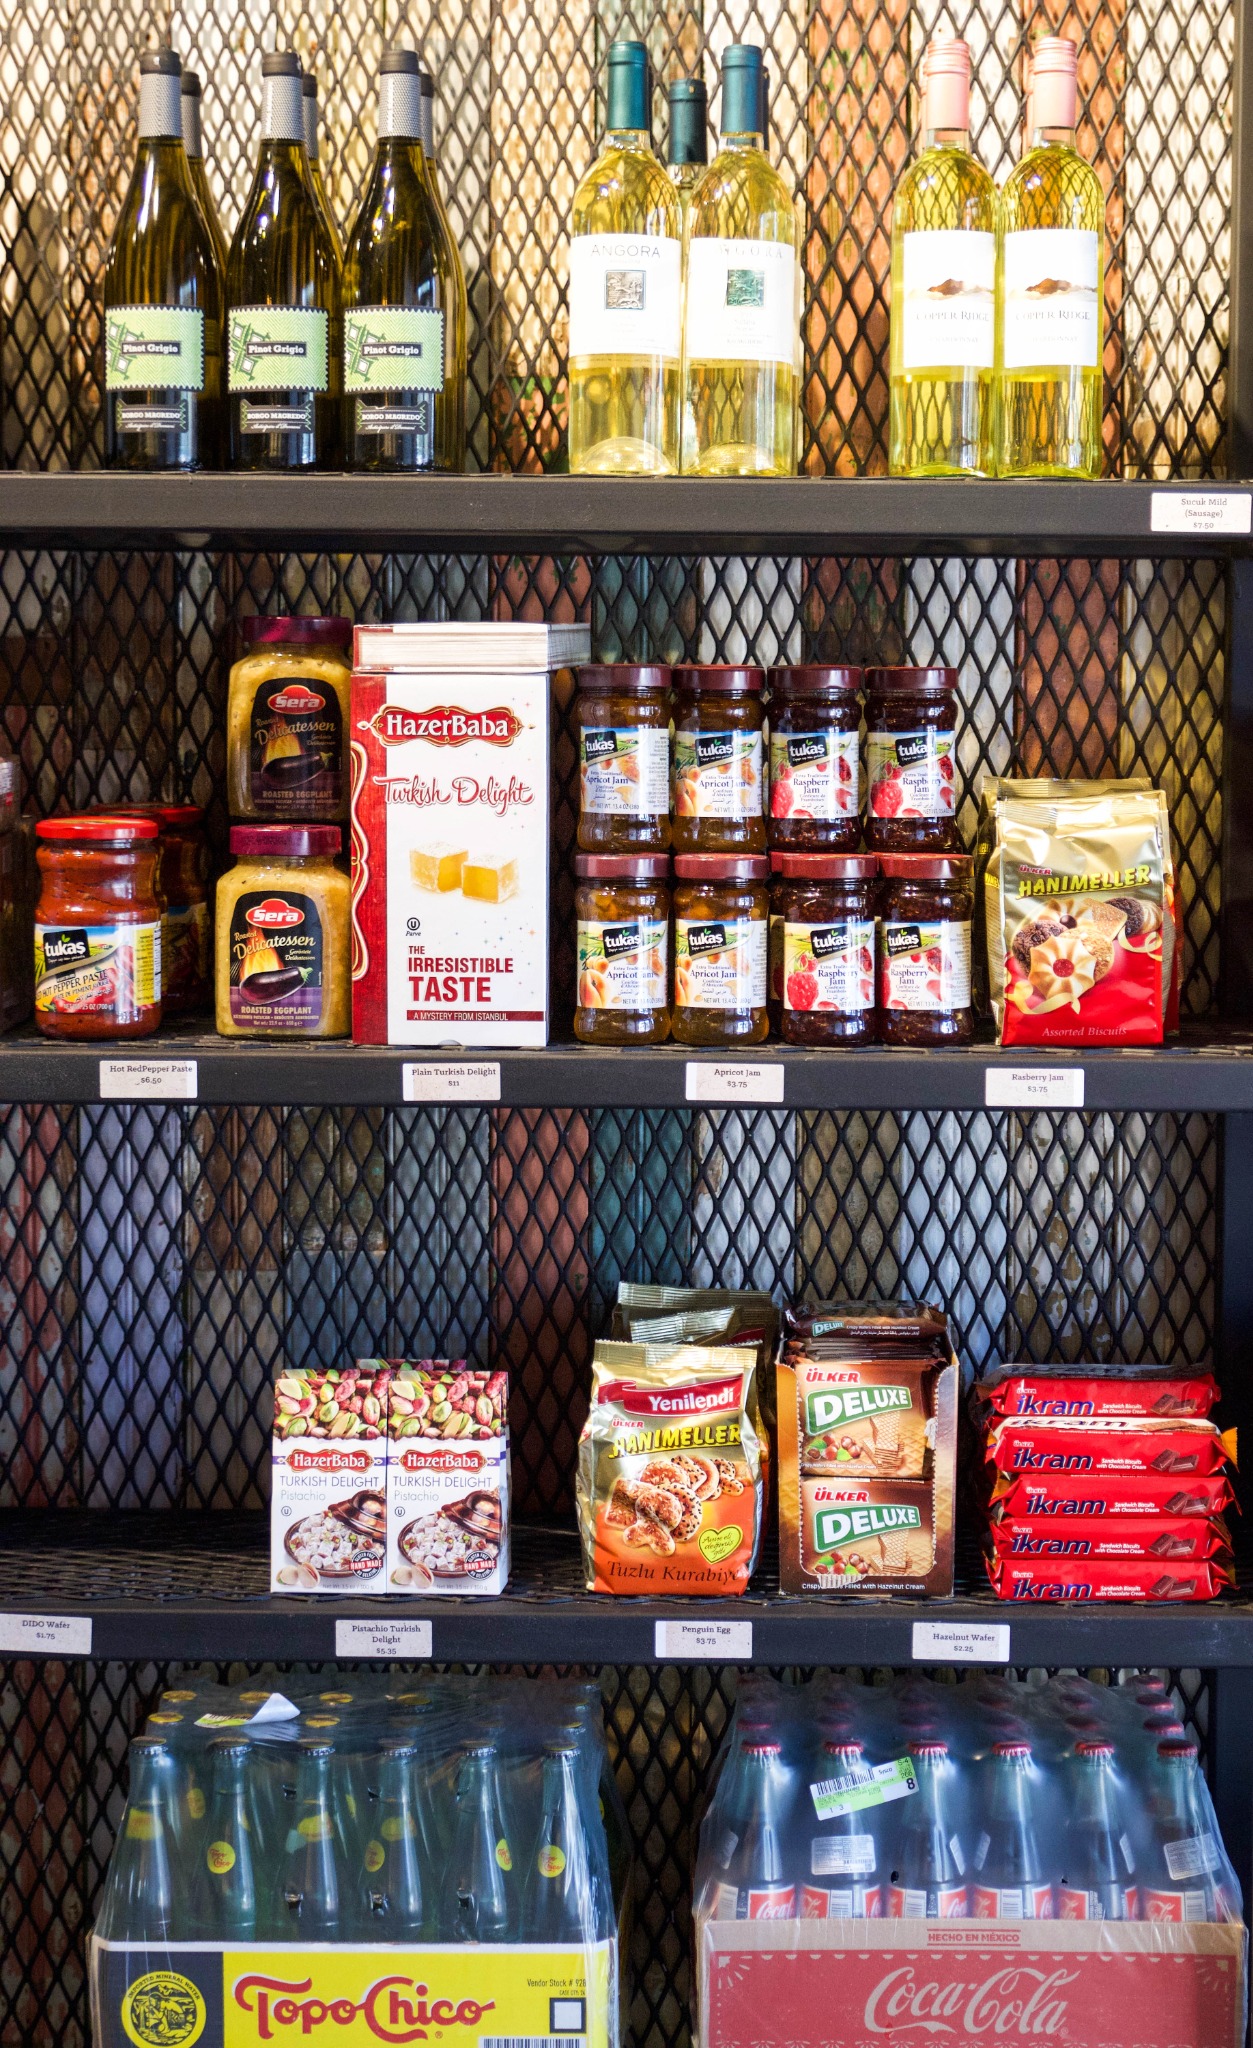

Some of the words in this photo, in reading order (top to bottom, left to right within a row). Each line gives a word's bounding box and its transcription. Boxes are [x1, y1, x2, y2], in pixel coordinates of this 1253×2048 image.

[590, 245, 660, 258] ANGORA
[961, 309, 989, 321] RIDGE
[1059, 309, 1090, 320] RIDGE
[122, 344, 145, 353] Pinot
[147, 344, 178, 354] Grigio
[248, 345, 272, 354] Pinot
[274, 345, 304, 355] Grigio
[363, 345, 387, 354] Pinot
[389, 345, 419, 356] Grigio
[1185, 509, 1223, 518] (Sausage)
[275, 696, 320, 708] Sera
[387, 715, 508, 736] HazerBaba
[254, 720, 336, 745] Delicatessen
[586, 774, 610, 784] Apricot
[612, 776, 628, 784] Jam
[699, 780, 729, 789] Apricot
[793, 778, 829, 787] Raspberr
[373, 775, 451, 807] Turkish
[452, 776, 534, 816] Delight
[1018, 865, 1150, 896] HANIMELLER
[253, 909, 299, 922] Sera
[233, 936, 316, 959] Delicatessen
[408, 946, 425, 954] THE
[408, 957, 513, 973] IRRESISTIBLE
[607, 971, 637, 979] Apricot
[690, 970, 719, 978] Apricot
[891, 969, 928, 978] Raspberry
[54, 978, 80, 993] PEPPER
[83, 969, 108, 984] PASTE
[899, 977, 914, 985] Jam
[408, 976, 491, 1002] TASTE
[420, 1012, 452, 1020] MYSTERY
[475, 1013, 508, 1021] ISTANBUL
[1042, 1027, 1085, 1037] Assorted
[1088, 1027, 1127, 1036] Biscuits
[127, 1065, 169, 1073] RedPepper
[467, 1069, 496, 1077] Delight
[714, 1069, 743, 1077] Apricot
[1012, 1074, 1047, 1082] Rasberry
[815, 1322, 844, 1334] DELUXE
[806, 1367, 860, 1383] ÜLKER
[649, 1387, 734, 1411] Yenilendi
[814, 1390, 908, 1426] DELUXE
[1016, 1395, 1094, 1416] ikram
[612, 1418, 644, 1428] ÜLKER
[608, 1424, 742, 1458] HANIMELLER
[294, 1454, 365, 1467] HazerBaba
[408, 1454, 478, 1467] HazerBaba
[1013, 1448, 1093, 1470] ikram
[280, 1476, 327, 1486] TURKISH
[331, 1477, 379, 1487] DELIGHT
[393, 1476, 440, 1487] TURKISH
[445, 1477, 492, 1487] DELIGHT
[281, 1490, 325, 1500] Pistachio
[395, 1490, 439, 1501] Pistachio
[815, 1487, 869, 1502] ÜLKER
[1026, 1495, 1106, 1515] ikram
[822, 1508, 916, 1544] DELUXE
[1012, 1534, 1091, 1554] ikram
[608, 1561, 655, 1579] Tuzlu
[1013, 1579, 1092, 1599] ikram
[372, 1636, 400, 1644] Delight
[907, 1778, 915, 1789] 8
[928, 1933, 964, 1943] HECHO
[967, 1933, 979, 1943] EN
[982, 1931, 1020, 1943] MÉXICO
[129, 1976, 154, 1998] IMPORTED
[156, 1975, 183, 1983] MINERAL
[185, 1982, 200, 2000] WATER
[527, 1979, 547, 1987] Vendor
[864, 1966, 1081, 2035] Coca-Cola
